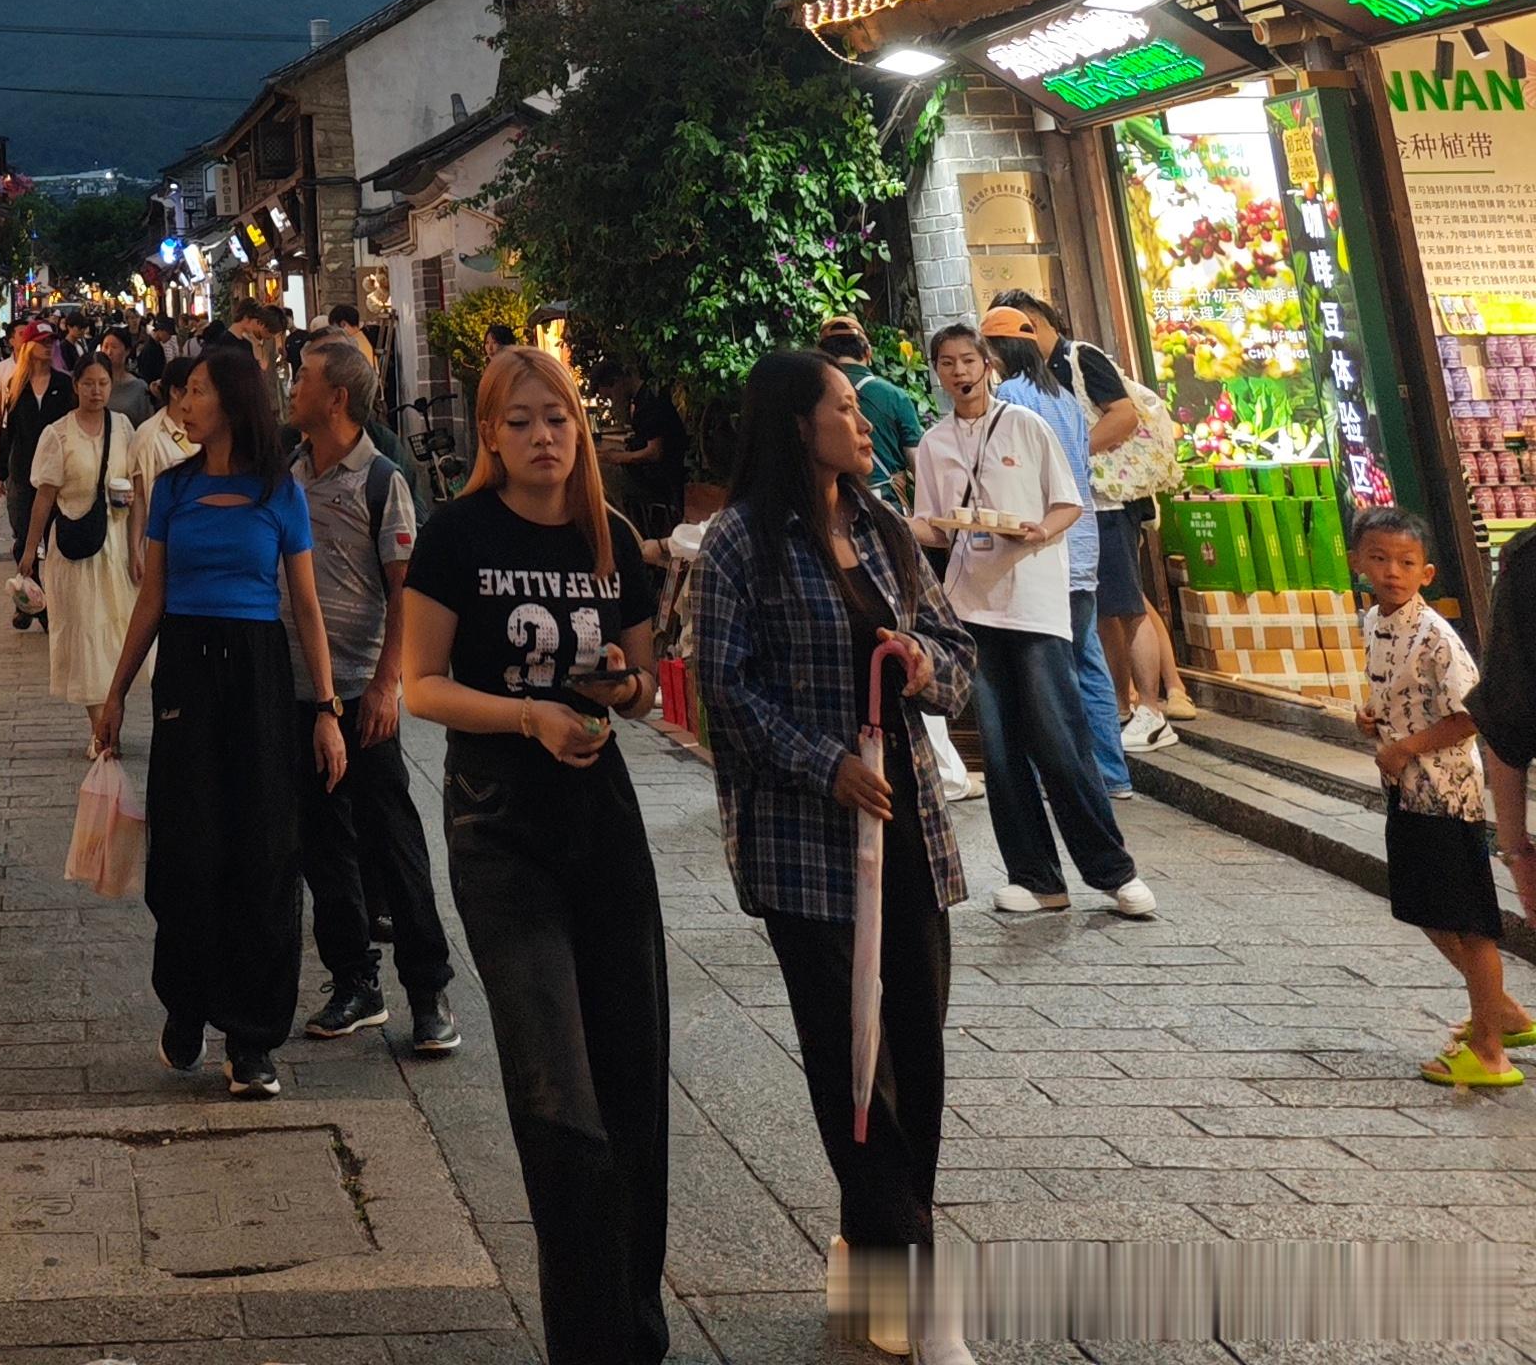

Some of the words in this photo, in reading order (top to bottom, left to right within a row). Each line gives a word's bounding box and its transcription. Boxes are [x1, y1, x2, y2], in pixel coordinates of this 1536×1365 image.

[1301, 201, 1374, 495] 咖啡豆体验区
